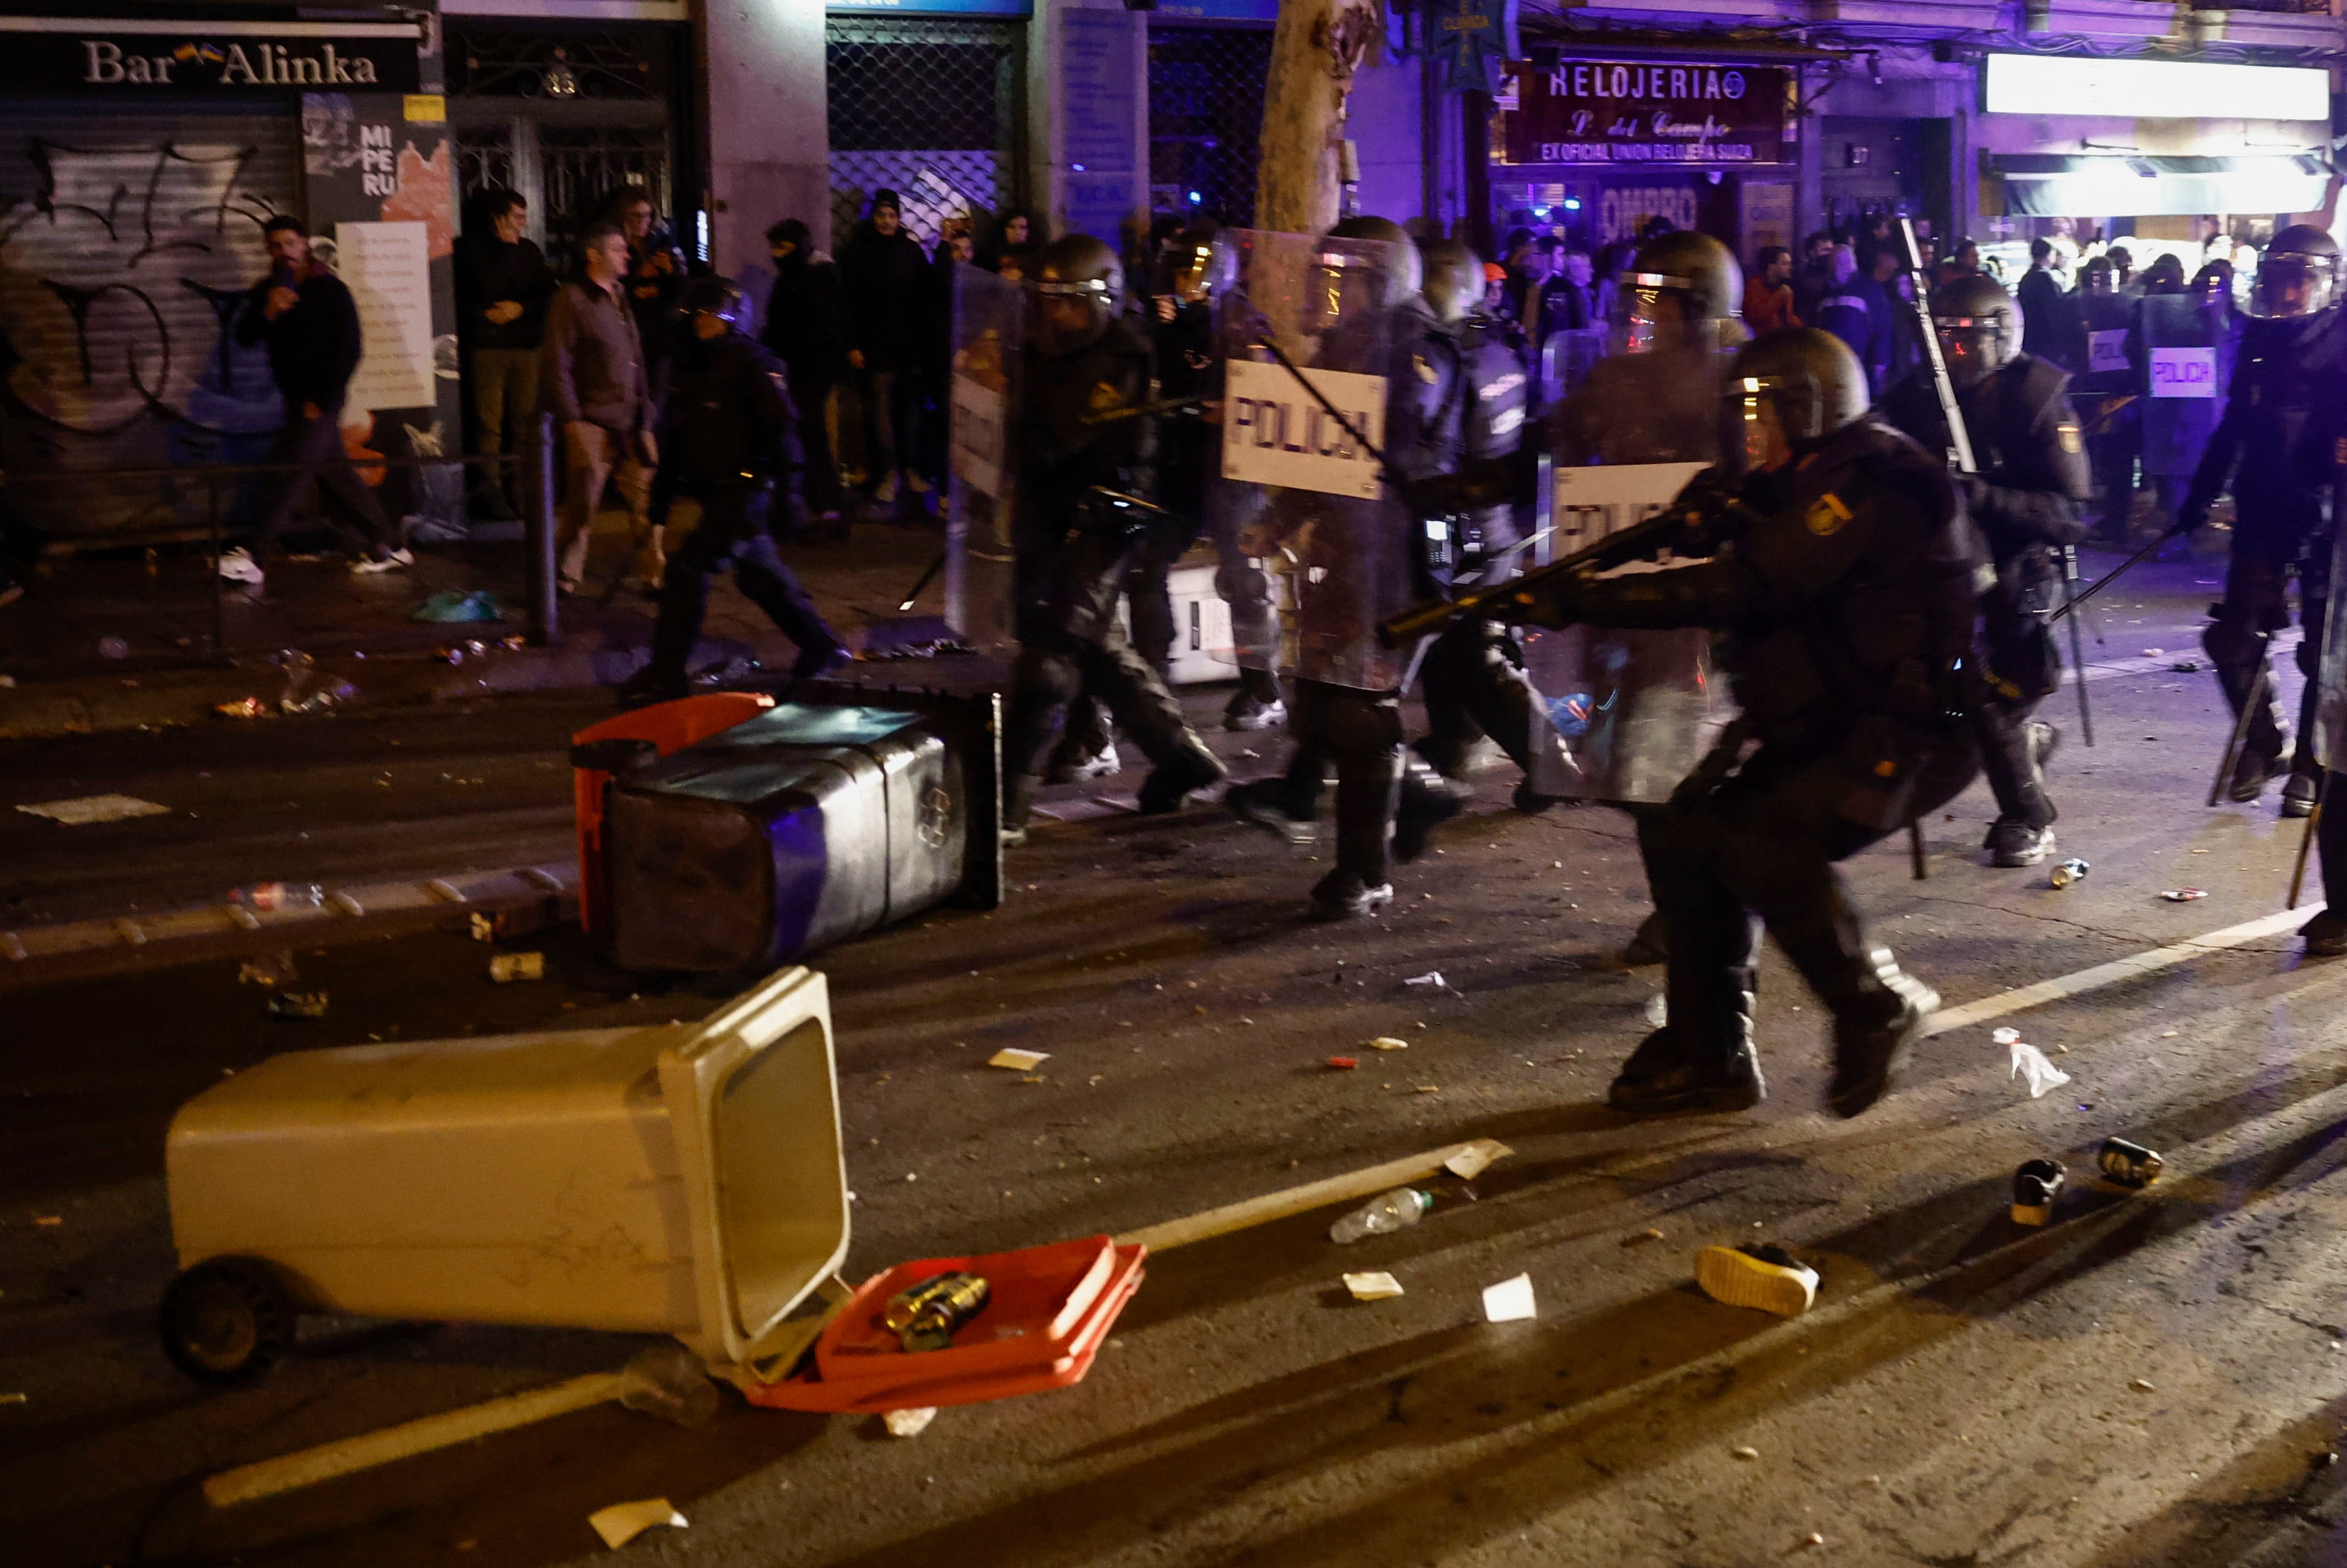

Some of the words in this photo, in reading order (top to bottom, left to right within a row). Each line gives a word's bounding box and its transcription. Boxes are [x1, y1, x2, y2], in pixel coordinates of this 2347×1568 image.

[80, 40, 177, 84] Bar
[218, 42, 380, 84] Alinka
[1549, 65, 1721, 100] RELOJERIA
[360, 125, 393, 149] MI
[361, 149, 395, 173] PE
[362, 172, 396, 197] RU
